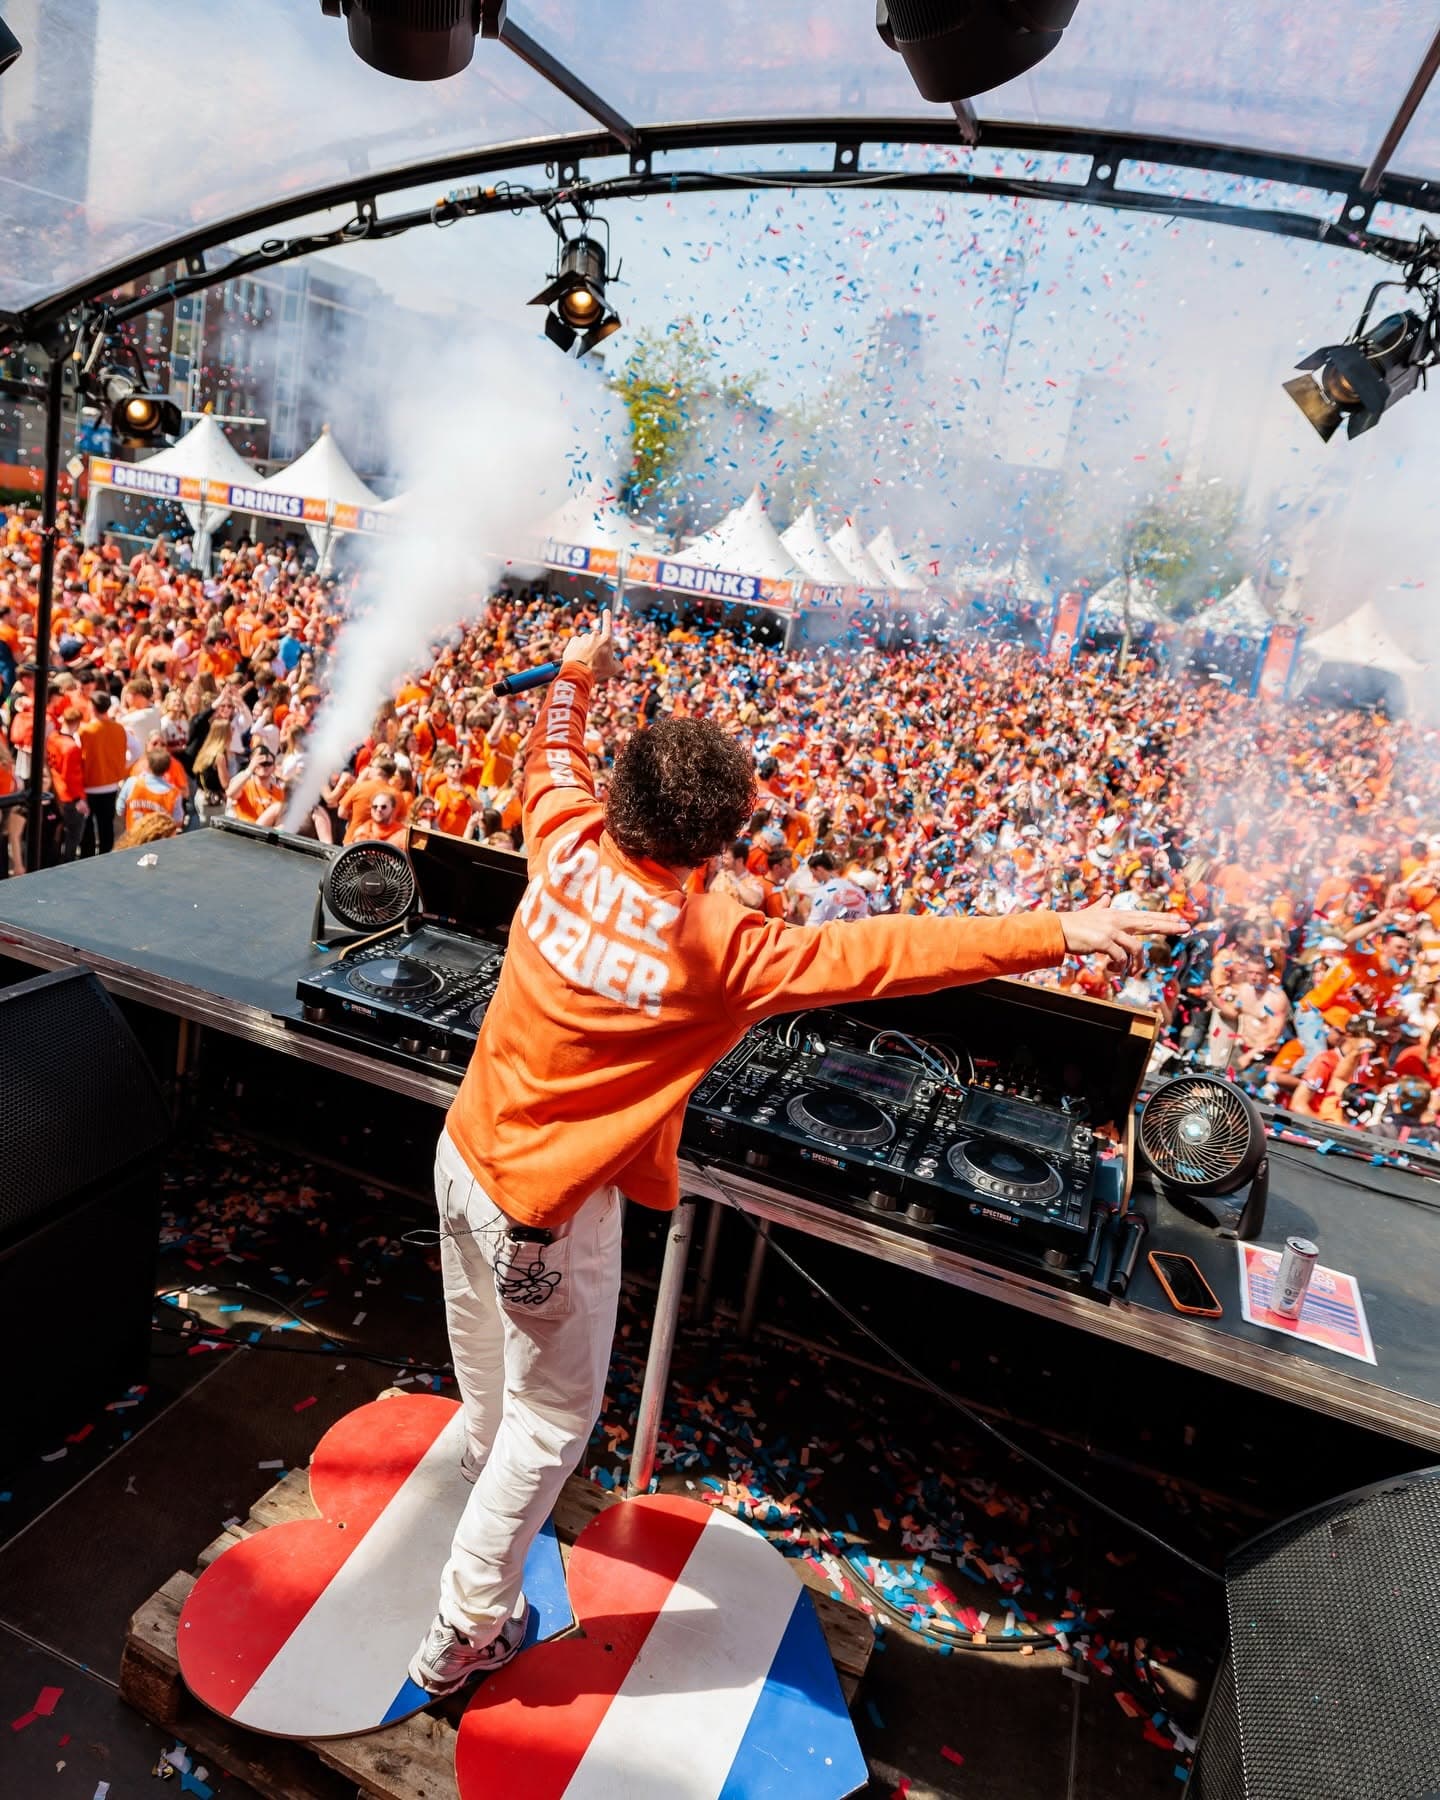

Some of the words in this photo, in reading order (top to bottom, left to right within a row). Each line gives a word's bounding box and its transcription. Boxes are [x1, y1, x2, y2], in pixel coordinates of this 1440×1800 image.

[114, 465, 178, 496] DRINKS
[231, 487, 300, 515] DRINKS
[544, 543, 586, 567] NKS
[661, 563, 757, 599] DRINKS
